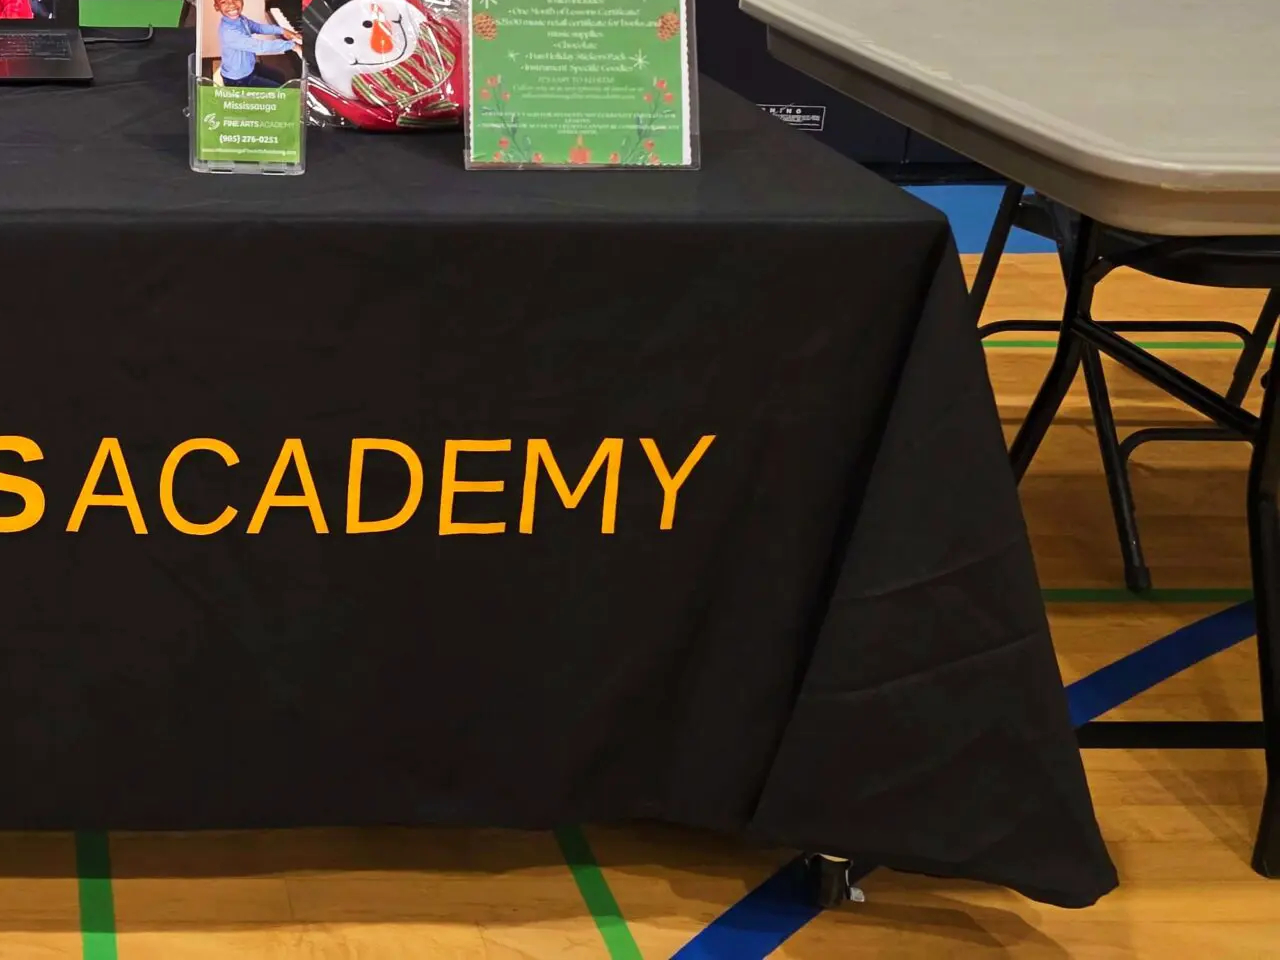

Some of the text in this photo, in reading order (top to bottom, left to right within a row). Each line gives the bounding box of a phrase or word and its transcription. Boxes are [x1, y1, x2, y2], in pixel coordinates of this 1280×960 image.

[215, 90, 286, 100] Music Lessons in
[223, 101, 277, 113] Mississauga
[239, 120, 260, 128] ARTS
[66, 434, 716, 536] ACADEMY
